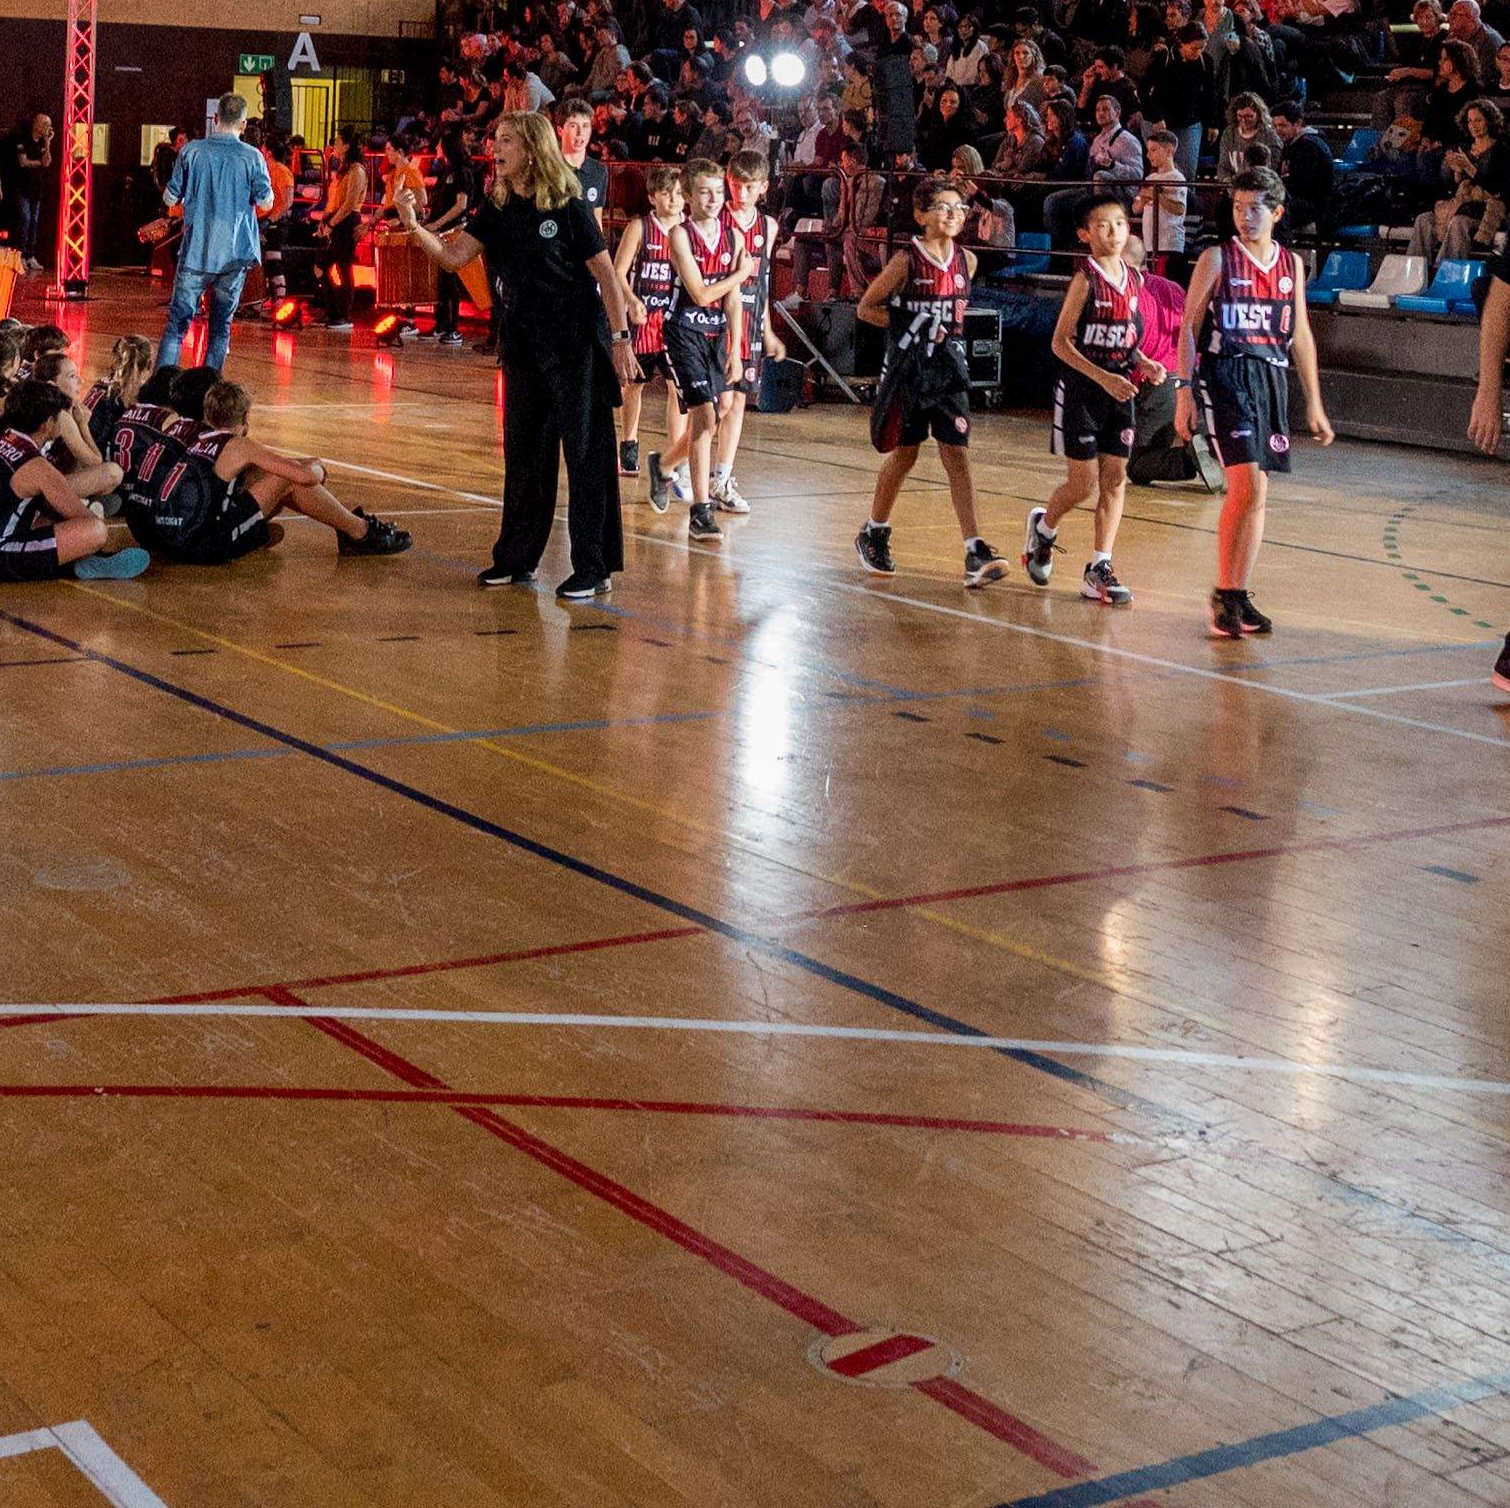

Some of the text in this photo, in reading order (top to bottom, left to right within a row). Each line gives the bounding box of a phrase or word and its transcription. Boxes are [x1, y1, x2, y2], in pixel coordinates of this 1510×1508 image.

[287, 32, 321, 71] A
[1221, 303, 1273, 331] UESC
[1083, 323, 1126, 348] UESC
